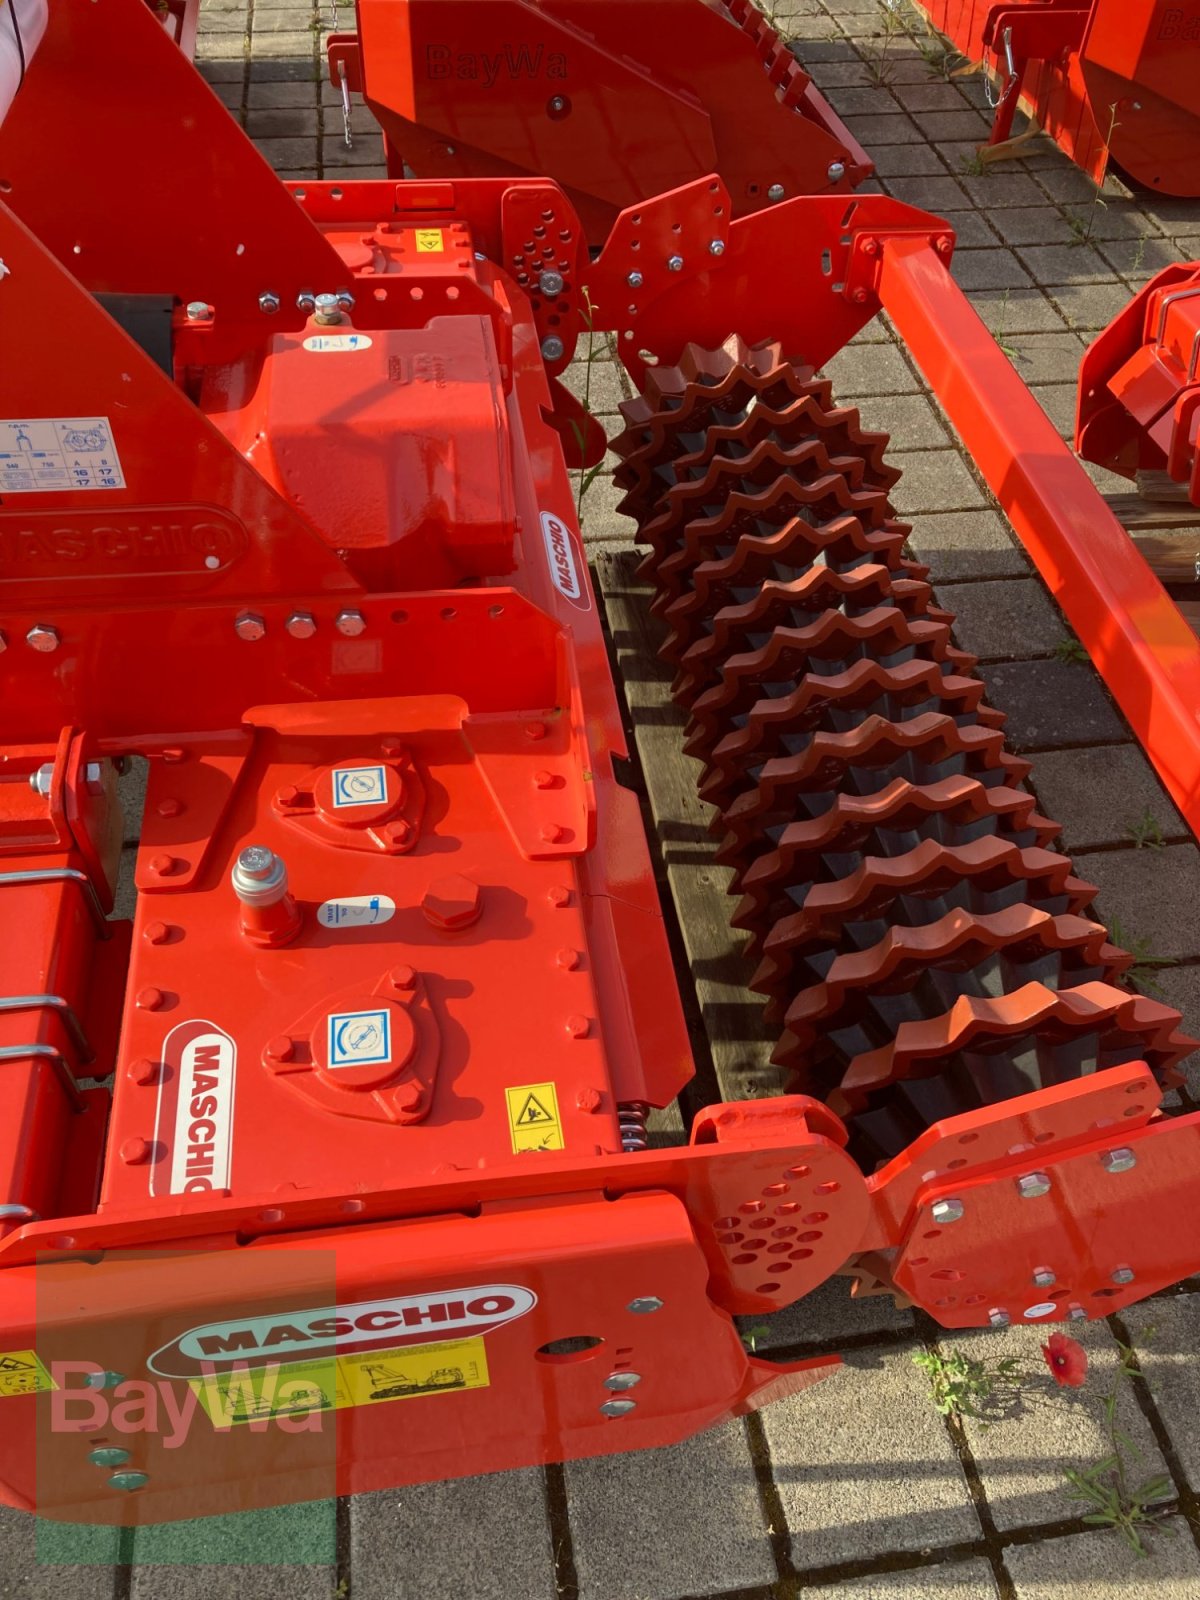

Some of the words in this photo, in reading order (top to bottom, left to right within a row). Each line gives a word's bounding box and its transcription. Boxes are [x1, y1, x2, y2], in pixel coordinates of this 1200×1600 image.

[427, 44, 567, 88] BayWa
[548, 520, 575, 594] MASCHIO
[197, 1295, 516, 1355] MASCHIO
